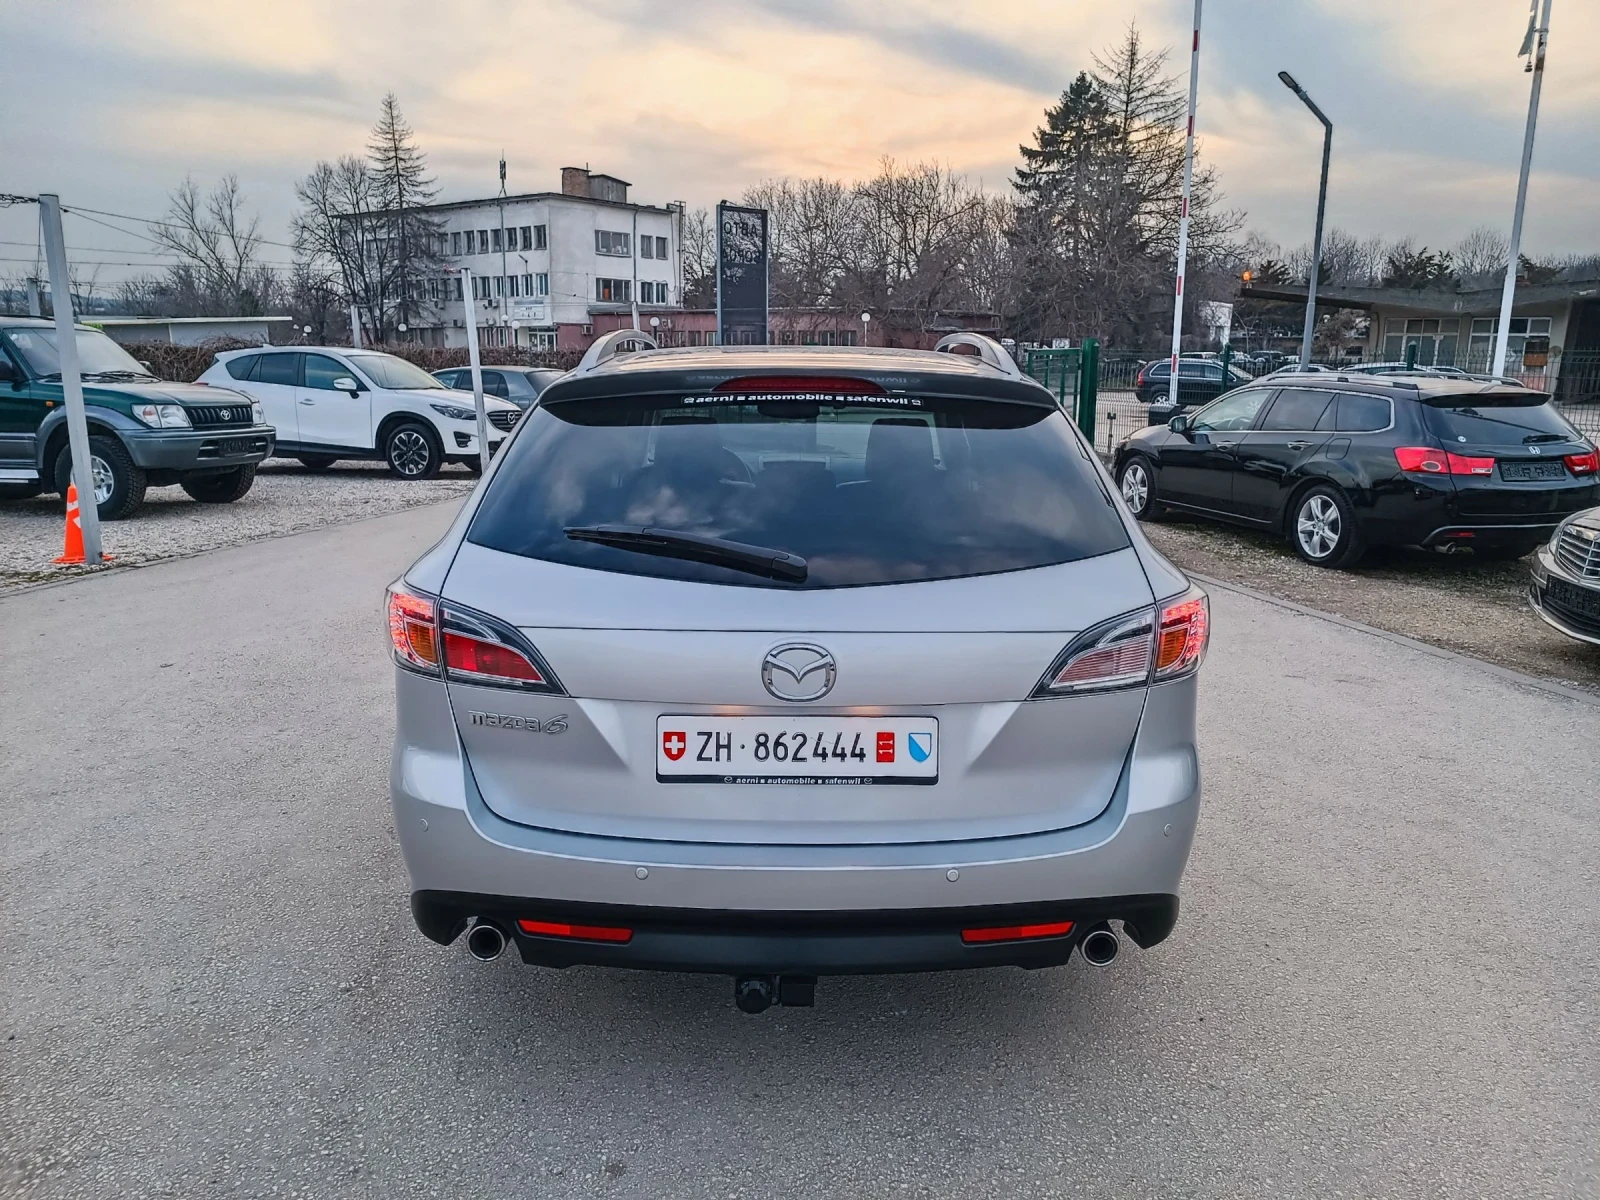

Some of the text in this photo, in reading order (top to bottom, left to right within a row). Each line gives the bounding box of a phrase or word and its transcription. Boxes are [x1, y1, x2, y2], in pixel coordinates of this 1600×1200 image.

[696, 393, 908, 405] aerni automobile safenwil
[696, 731, 866, 762] ZH 862444
[767, 776, 816, 784] automobile
